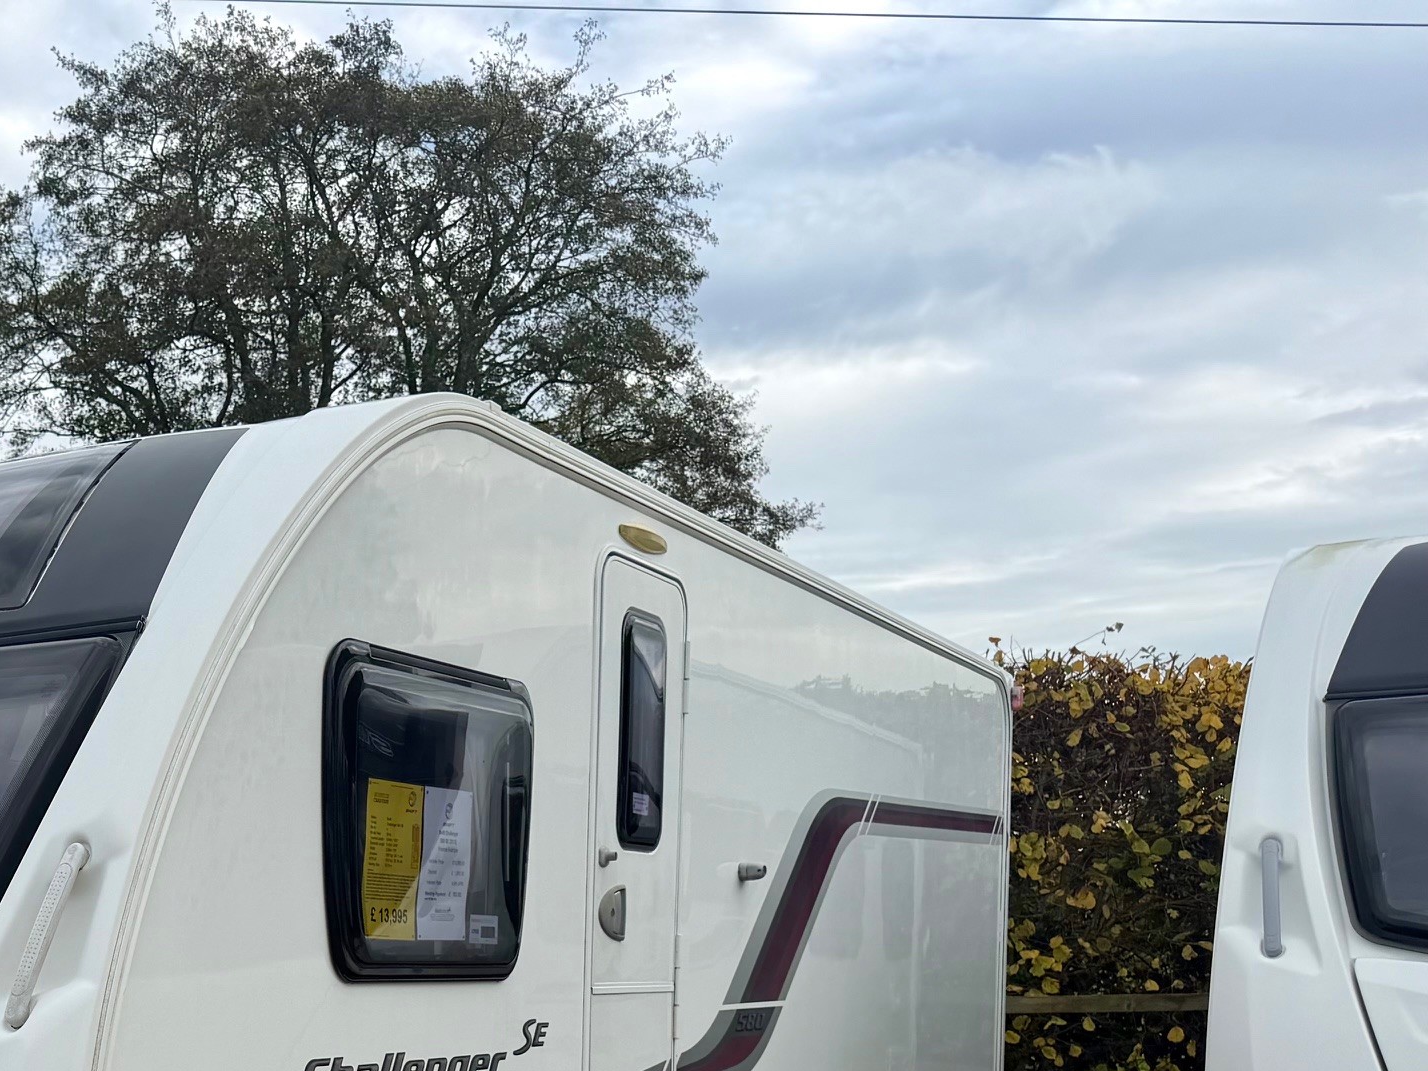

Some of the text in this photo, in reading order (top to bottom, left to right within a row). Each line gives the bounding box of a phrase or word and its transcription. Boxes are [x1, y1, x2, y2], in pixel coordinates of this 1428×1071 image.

[378, 908, 408, 925] 13,995
[735, 1013, 766, 1032] 580
[513, 1018, 549, 1056] SE
